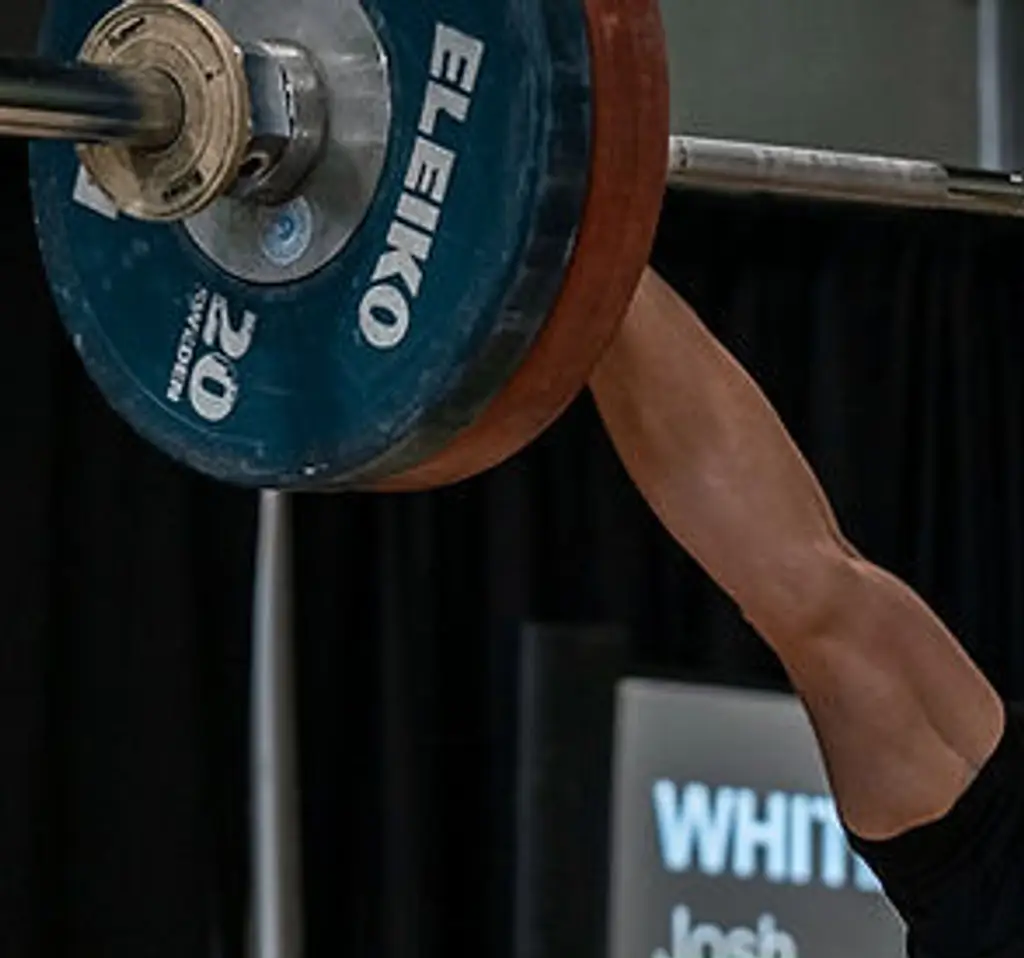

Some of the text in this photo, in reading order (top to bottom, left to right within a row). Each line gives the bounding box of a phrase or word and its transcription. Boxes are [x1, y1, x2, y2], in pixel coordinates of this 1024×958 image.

[358, 22, 486, 349] ELEIKO
[189, 292, 256, 422] 20
[652, 777, 883, 893] WHIT
